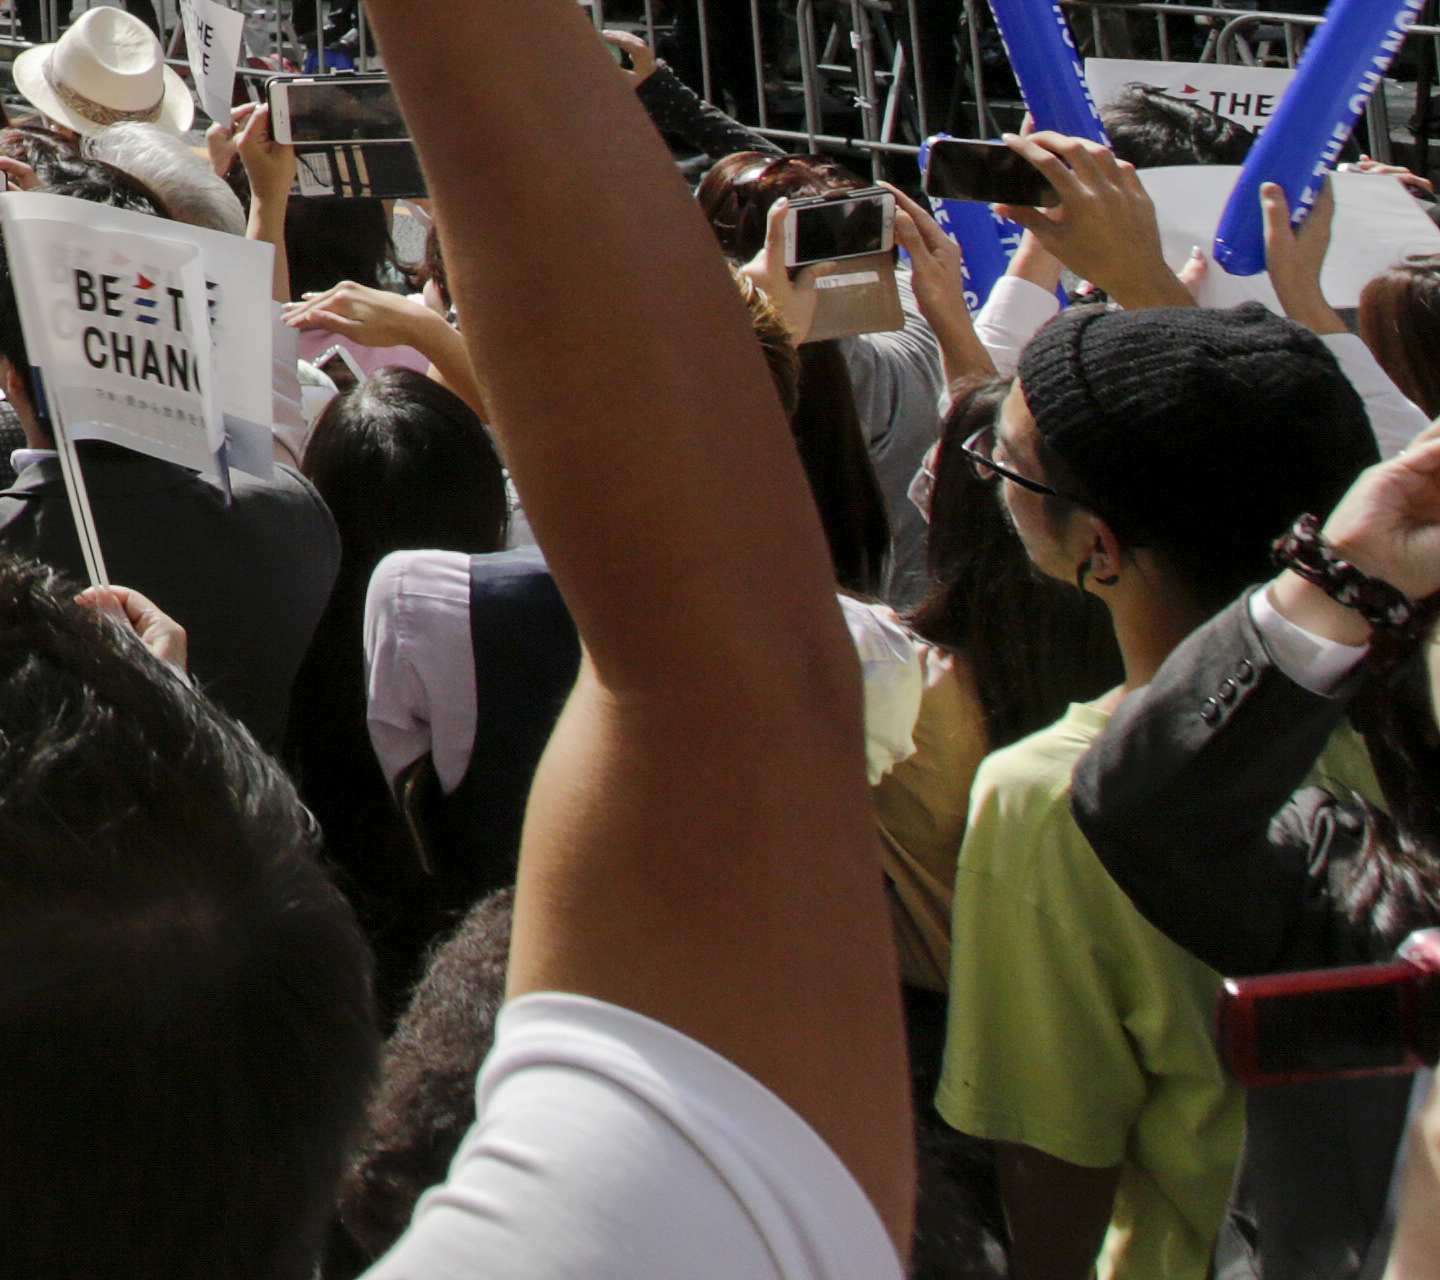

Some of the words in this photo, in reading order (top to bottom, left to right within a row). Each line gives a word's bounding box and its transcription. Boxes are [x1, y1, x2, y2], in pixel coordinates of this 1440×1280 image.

[1209, 91, 1276, 117] THE
[1312, 121, 1353, 180] THE
[74, 267, 125, 318] BE
